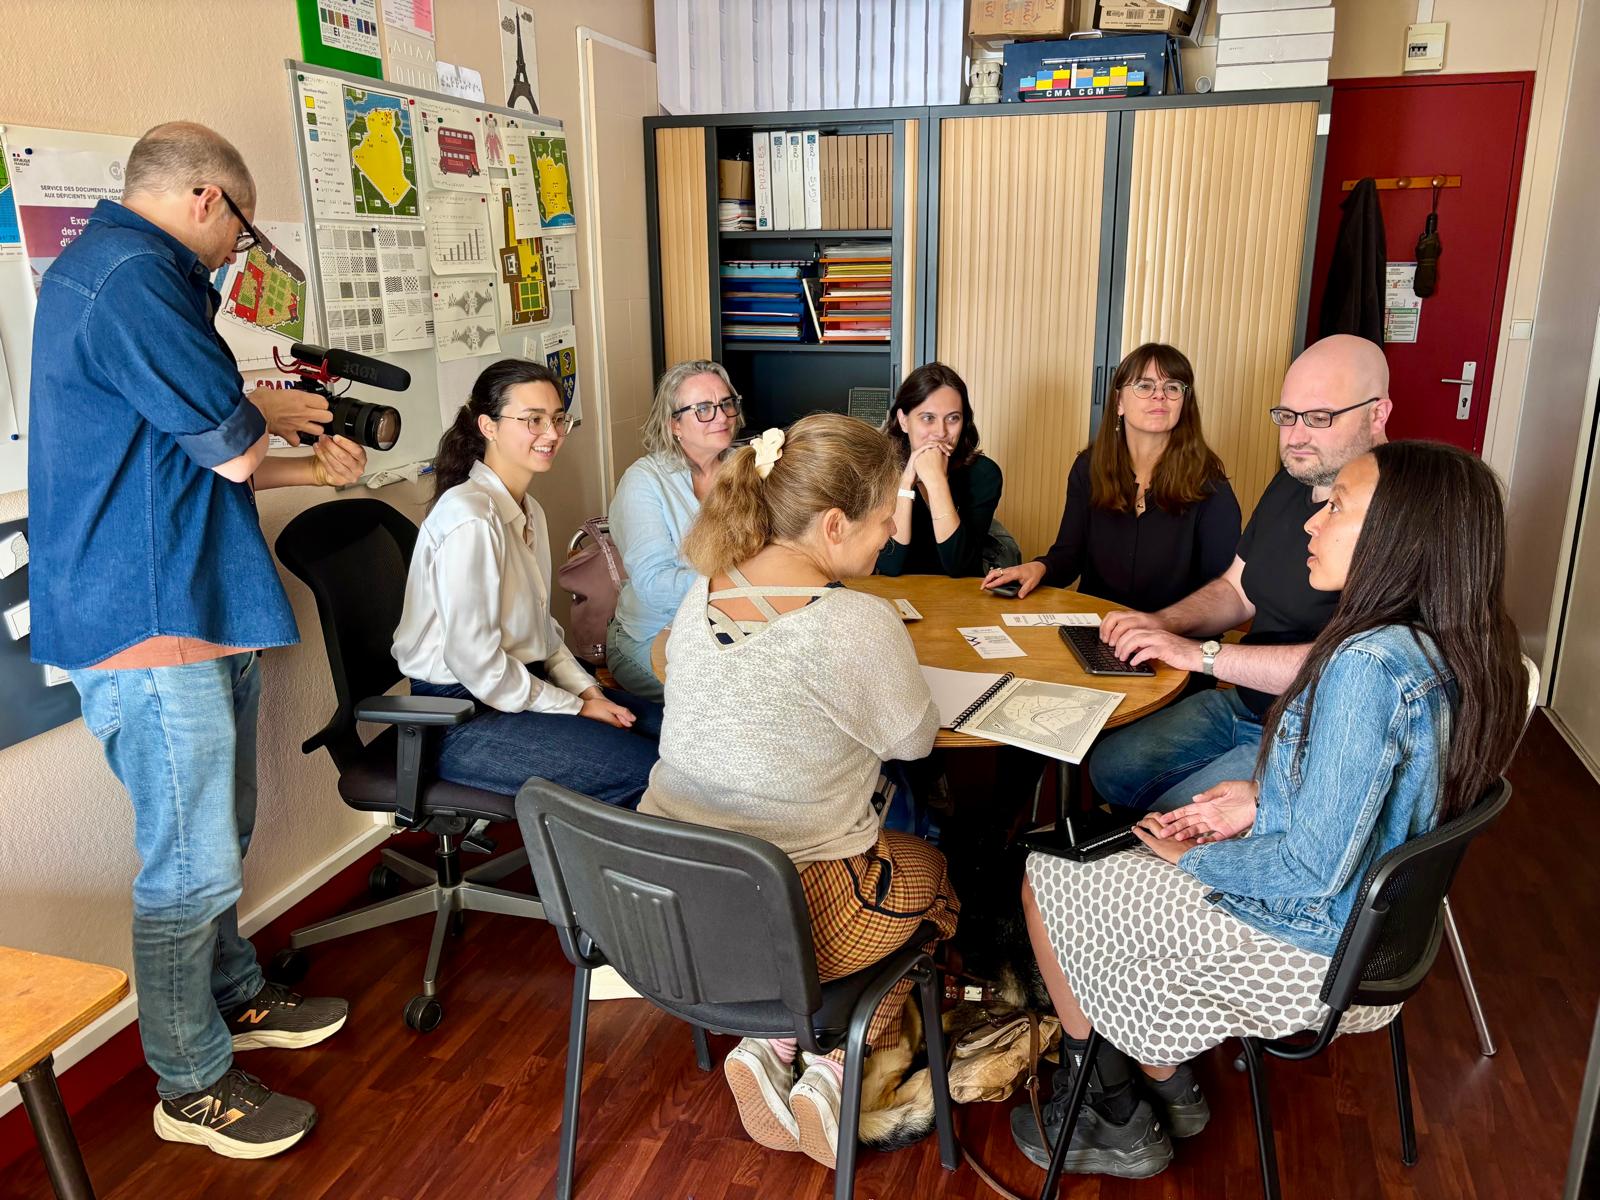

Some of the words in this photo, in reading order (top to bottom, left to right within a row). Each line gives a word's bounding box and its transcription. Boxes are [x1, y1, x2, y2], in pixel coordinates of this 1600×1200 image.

[1046, 88, 1071, 97] CMA
[1079, 87, 1104, 96] CGM
[61, 226, 77, 236] des
